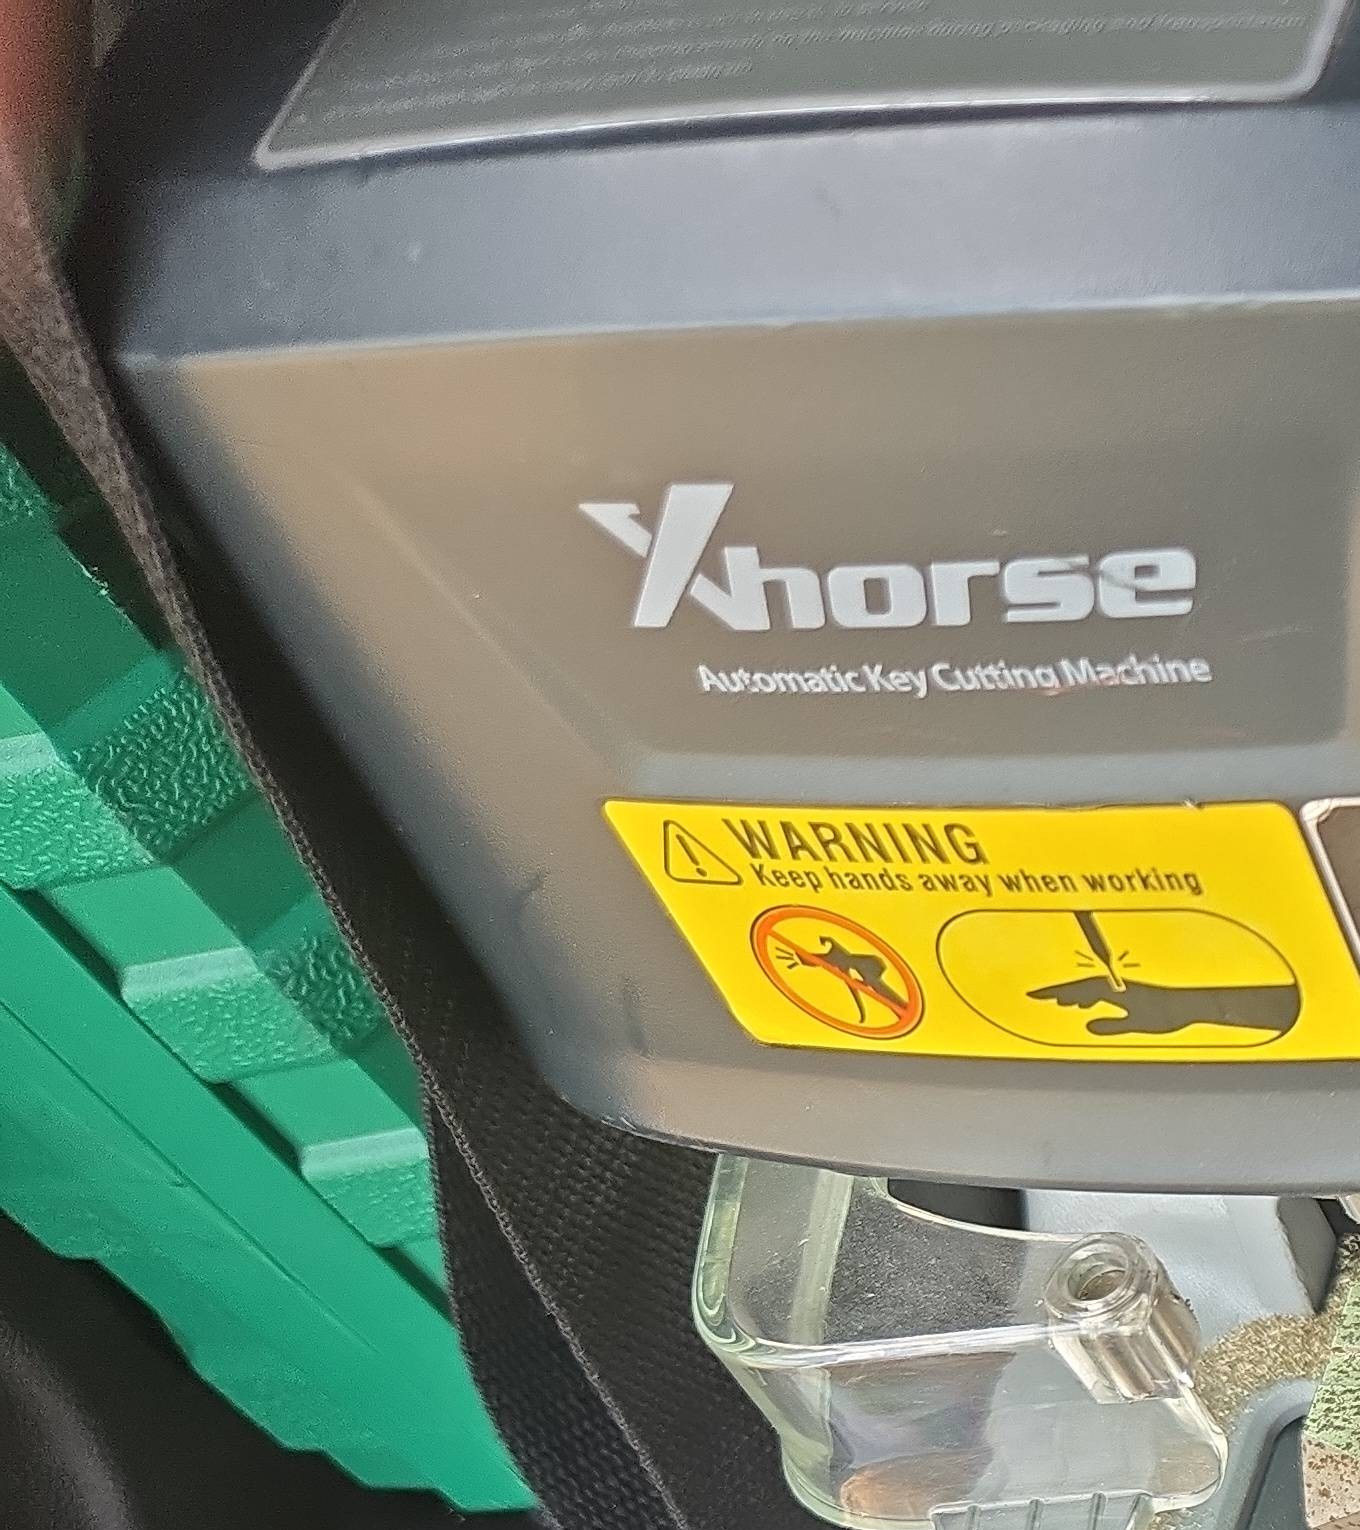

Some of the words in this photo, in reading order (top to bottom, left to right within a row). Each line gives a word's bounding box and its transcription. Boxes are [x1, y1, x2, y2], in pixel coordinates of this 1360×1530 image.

[578, 483, 1198, 631] Xhorse
[698, 664, 866, 693] Automatic
[862, 663, 927, 699] Key
[931, 662, 1059, 693] Cutting
[1058, 653, 1213, 687] Machine
[722, 817, 990, 865] WARNING
[750, 863, 823, 894] Keep
[829, 866, 912, 893] hands
[917, 871, 994, 897] away
[998, 870, 1084, 894] when
[1081, 867, 1204, 896] working
